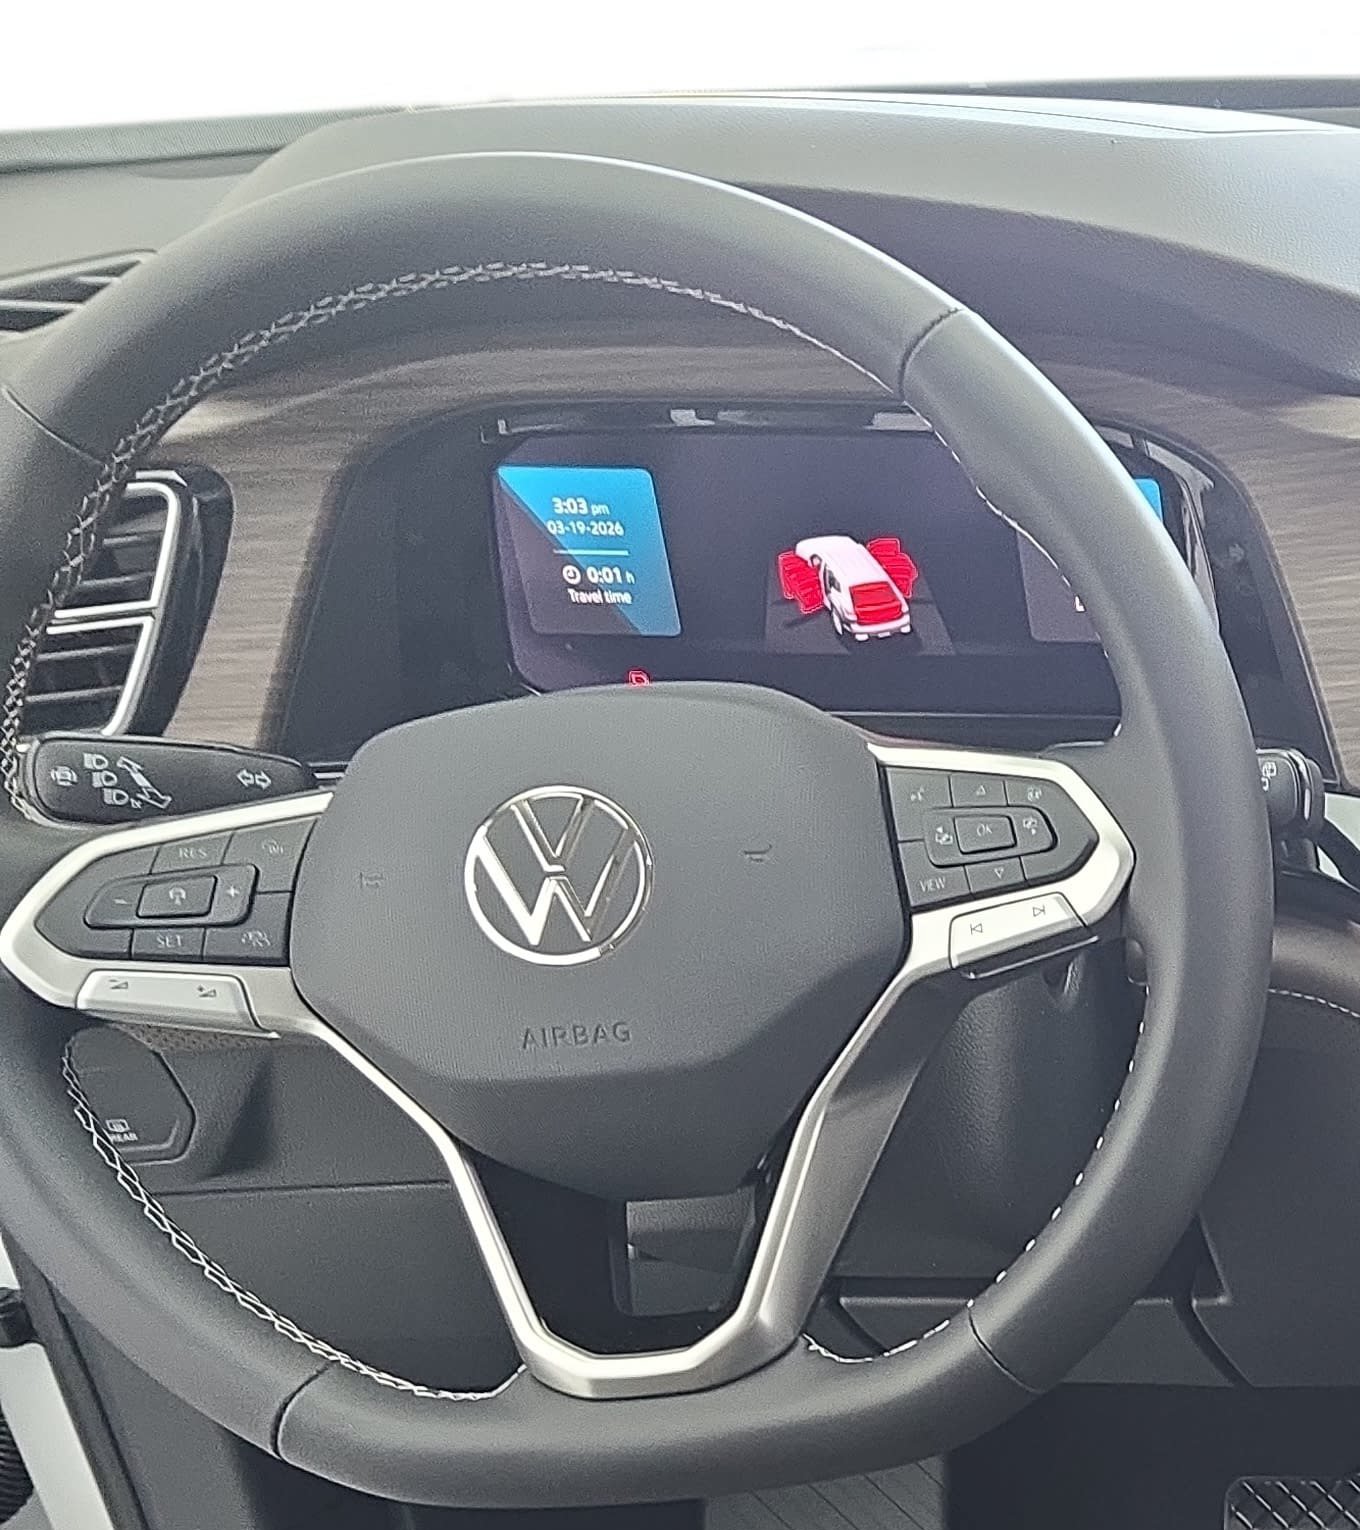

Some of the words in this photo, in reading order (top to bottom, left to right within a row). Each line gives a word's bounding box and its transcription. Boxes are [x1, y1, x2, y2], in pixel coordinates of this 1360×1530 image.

[552, 497, 588, 515] 3:03
[591, 503, 610, 517] pm
[547, 521, 625, 537] 03-19-2026
[586, 566, 621, 585] 0:01
[568, 588, 603, 604] Travel
[604, 589, 632, 605] time
[976, 823, 993, 837] OK
[919, 876, 946, 892] VIEW
[520, 1022, 632, 1051] AIRBAG
